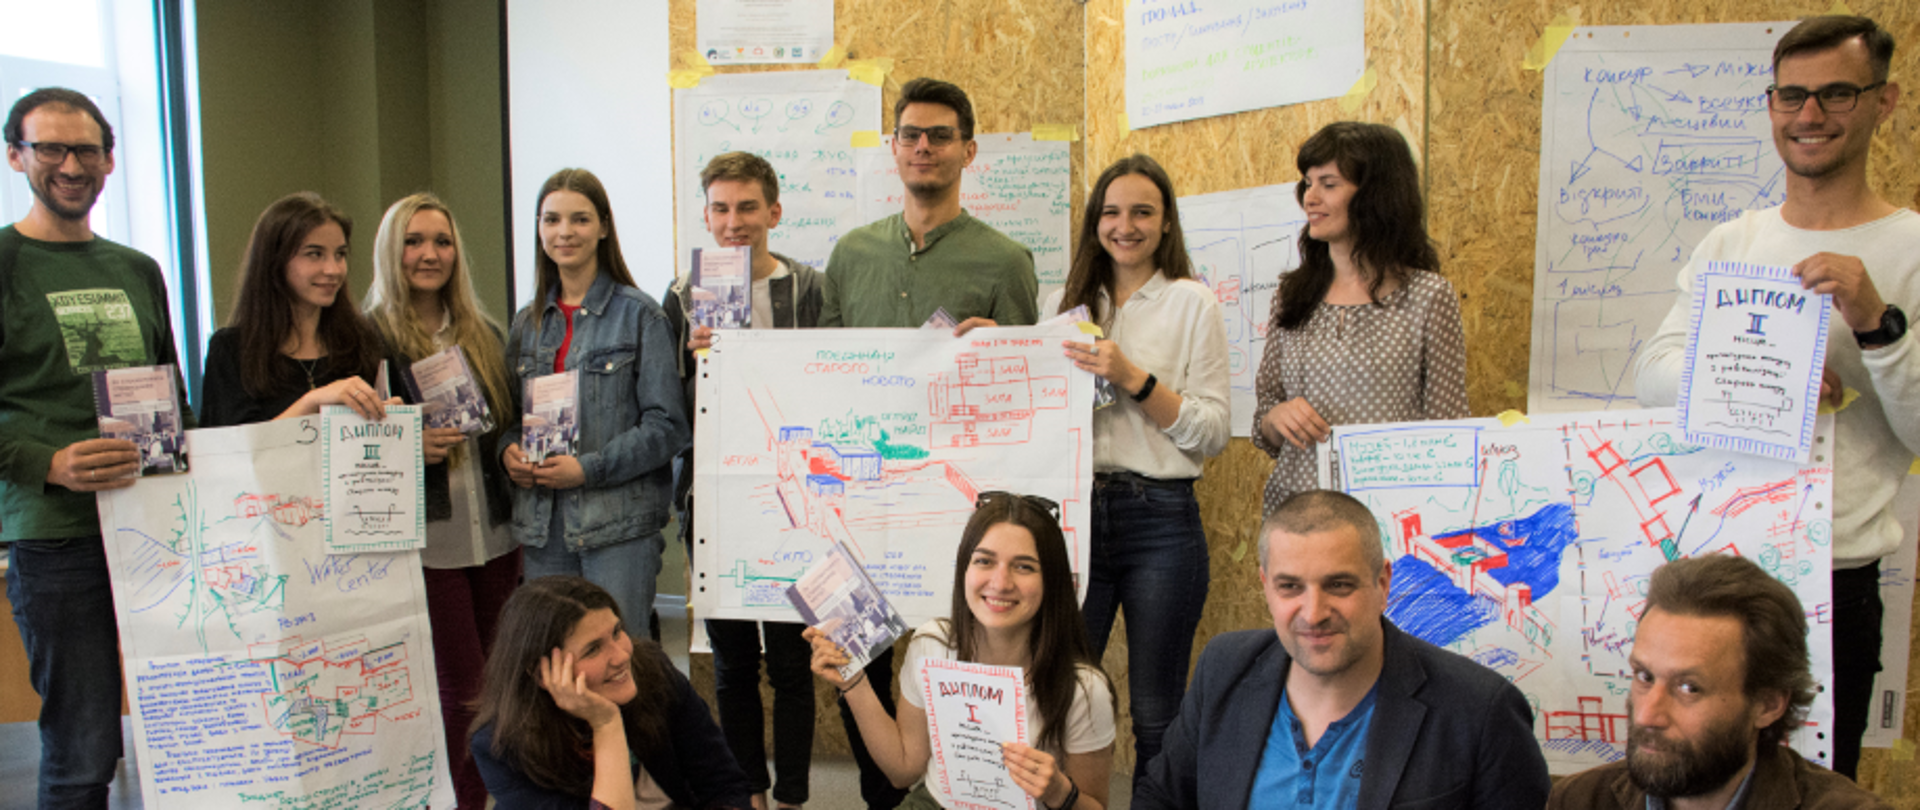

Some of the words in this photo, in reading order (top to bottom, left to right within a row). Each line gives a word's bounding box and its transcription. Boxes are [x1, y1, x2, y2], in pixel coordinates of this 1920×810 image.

[1716, 288, 1806, 315] ДИПЛОМ
[803, 363, 869, 375] СТАРОГО
[340, 423, 404, 442] ДИПЛОМ
[336, 558, 397, 594] Center
[938, 681, 1004, 706] ДИПЛОМ
